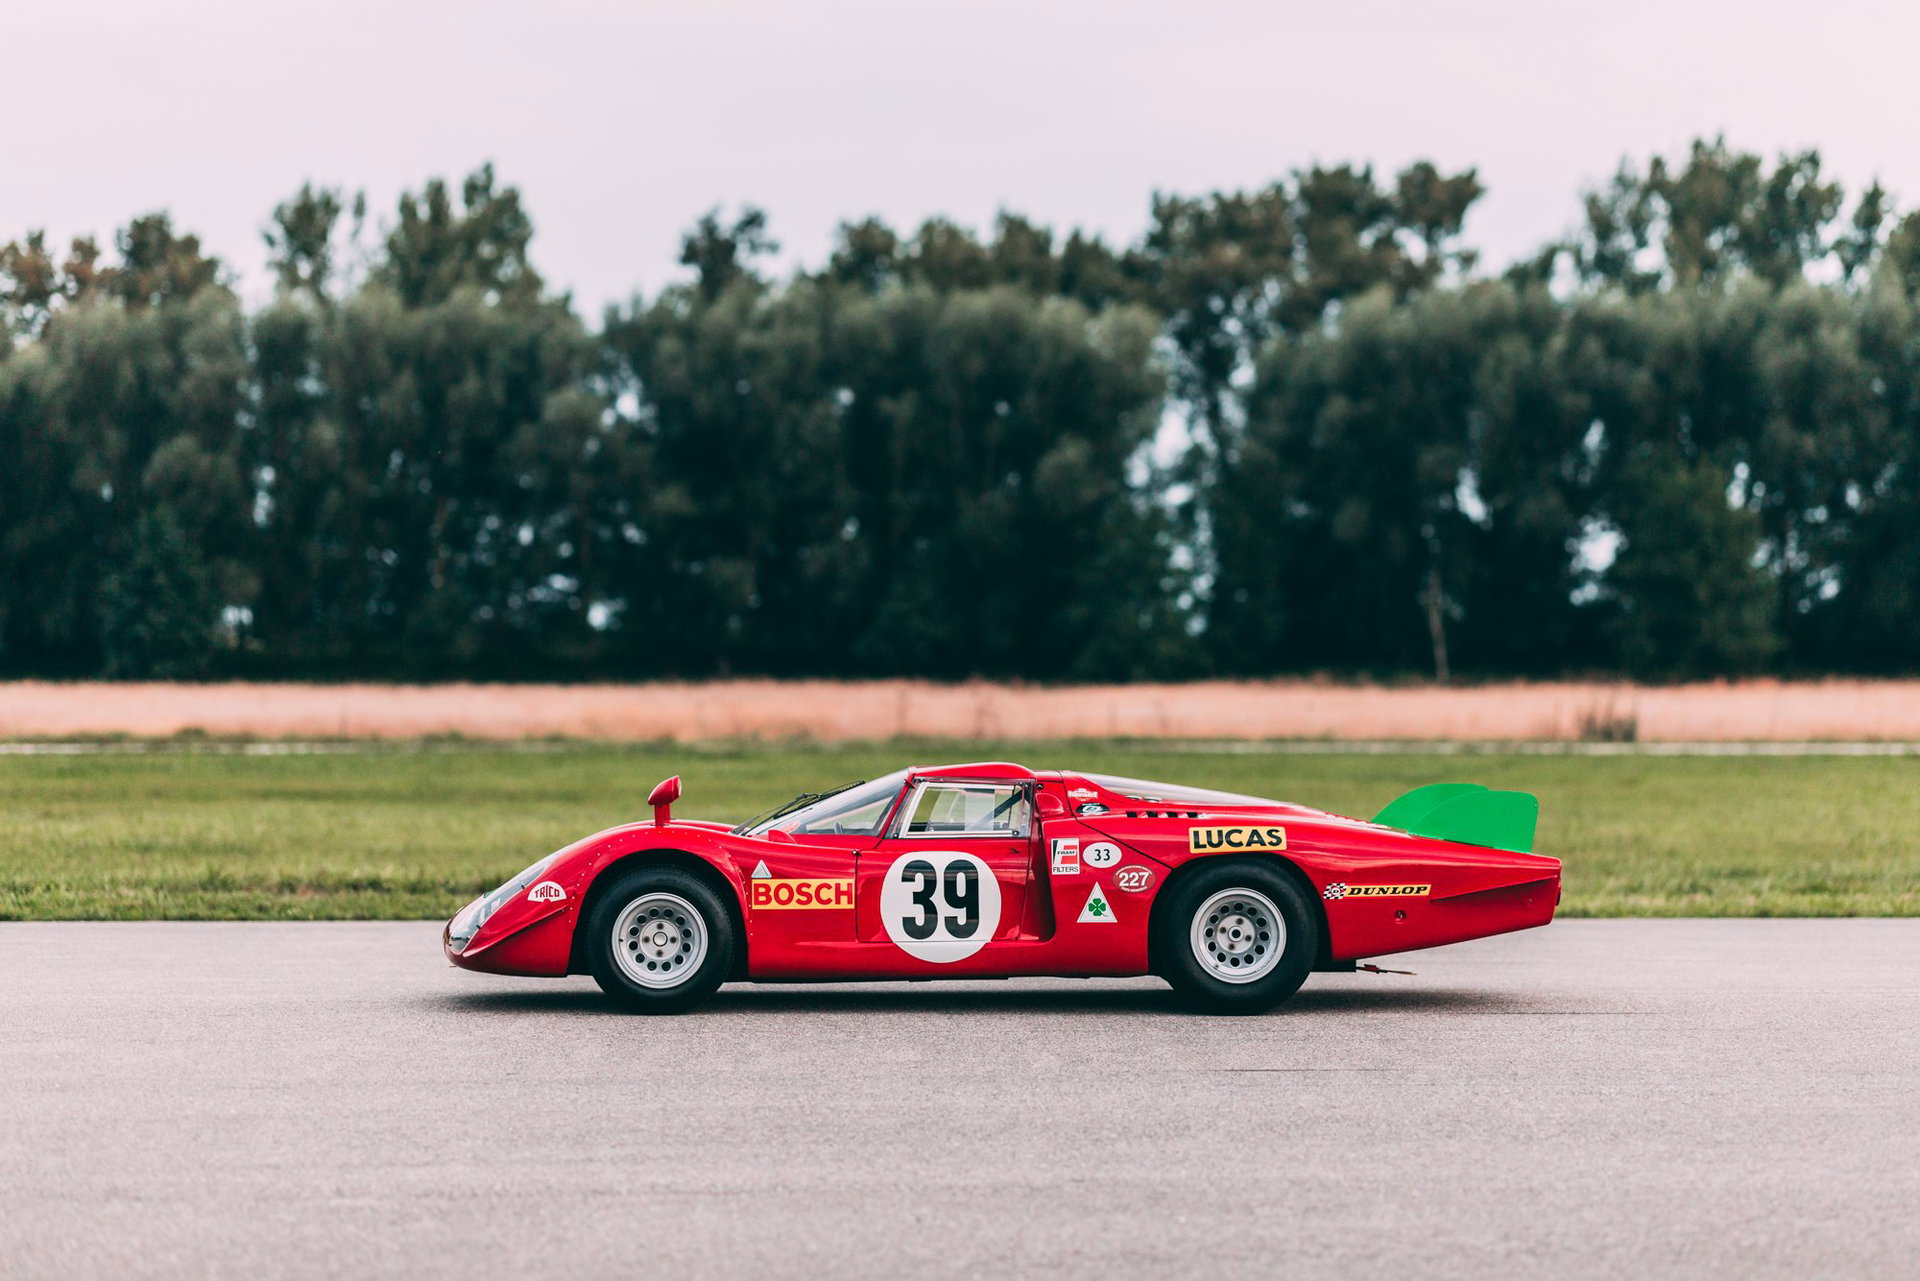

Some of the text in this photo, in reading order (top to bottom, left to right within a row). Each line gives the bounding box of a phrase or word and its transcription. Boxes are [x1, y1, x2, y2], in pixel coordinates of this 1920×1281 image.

[1193, 829, 1282, 849] LUCAS
[1094, 848, 1111, 862] 33
[1119, 871, 1149, 886] 227
[534, 884, 560, 898] TRICO
[753, 882, 853, 906] BOSCH
[1347, 886, 1428, 896] DUNLOP
[901, 859, 980, 940] 39
